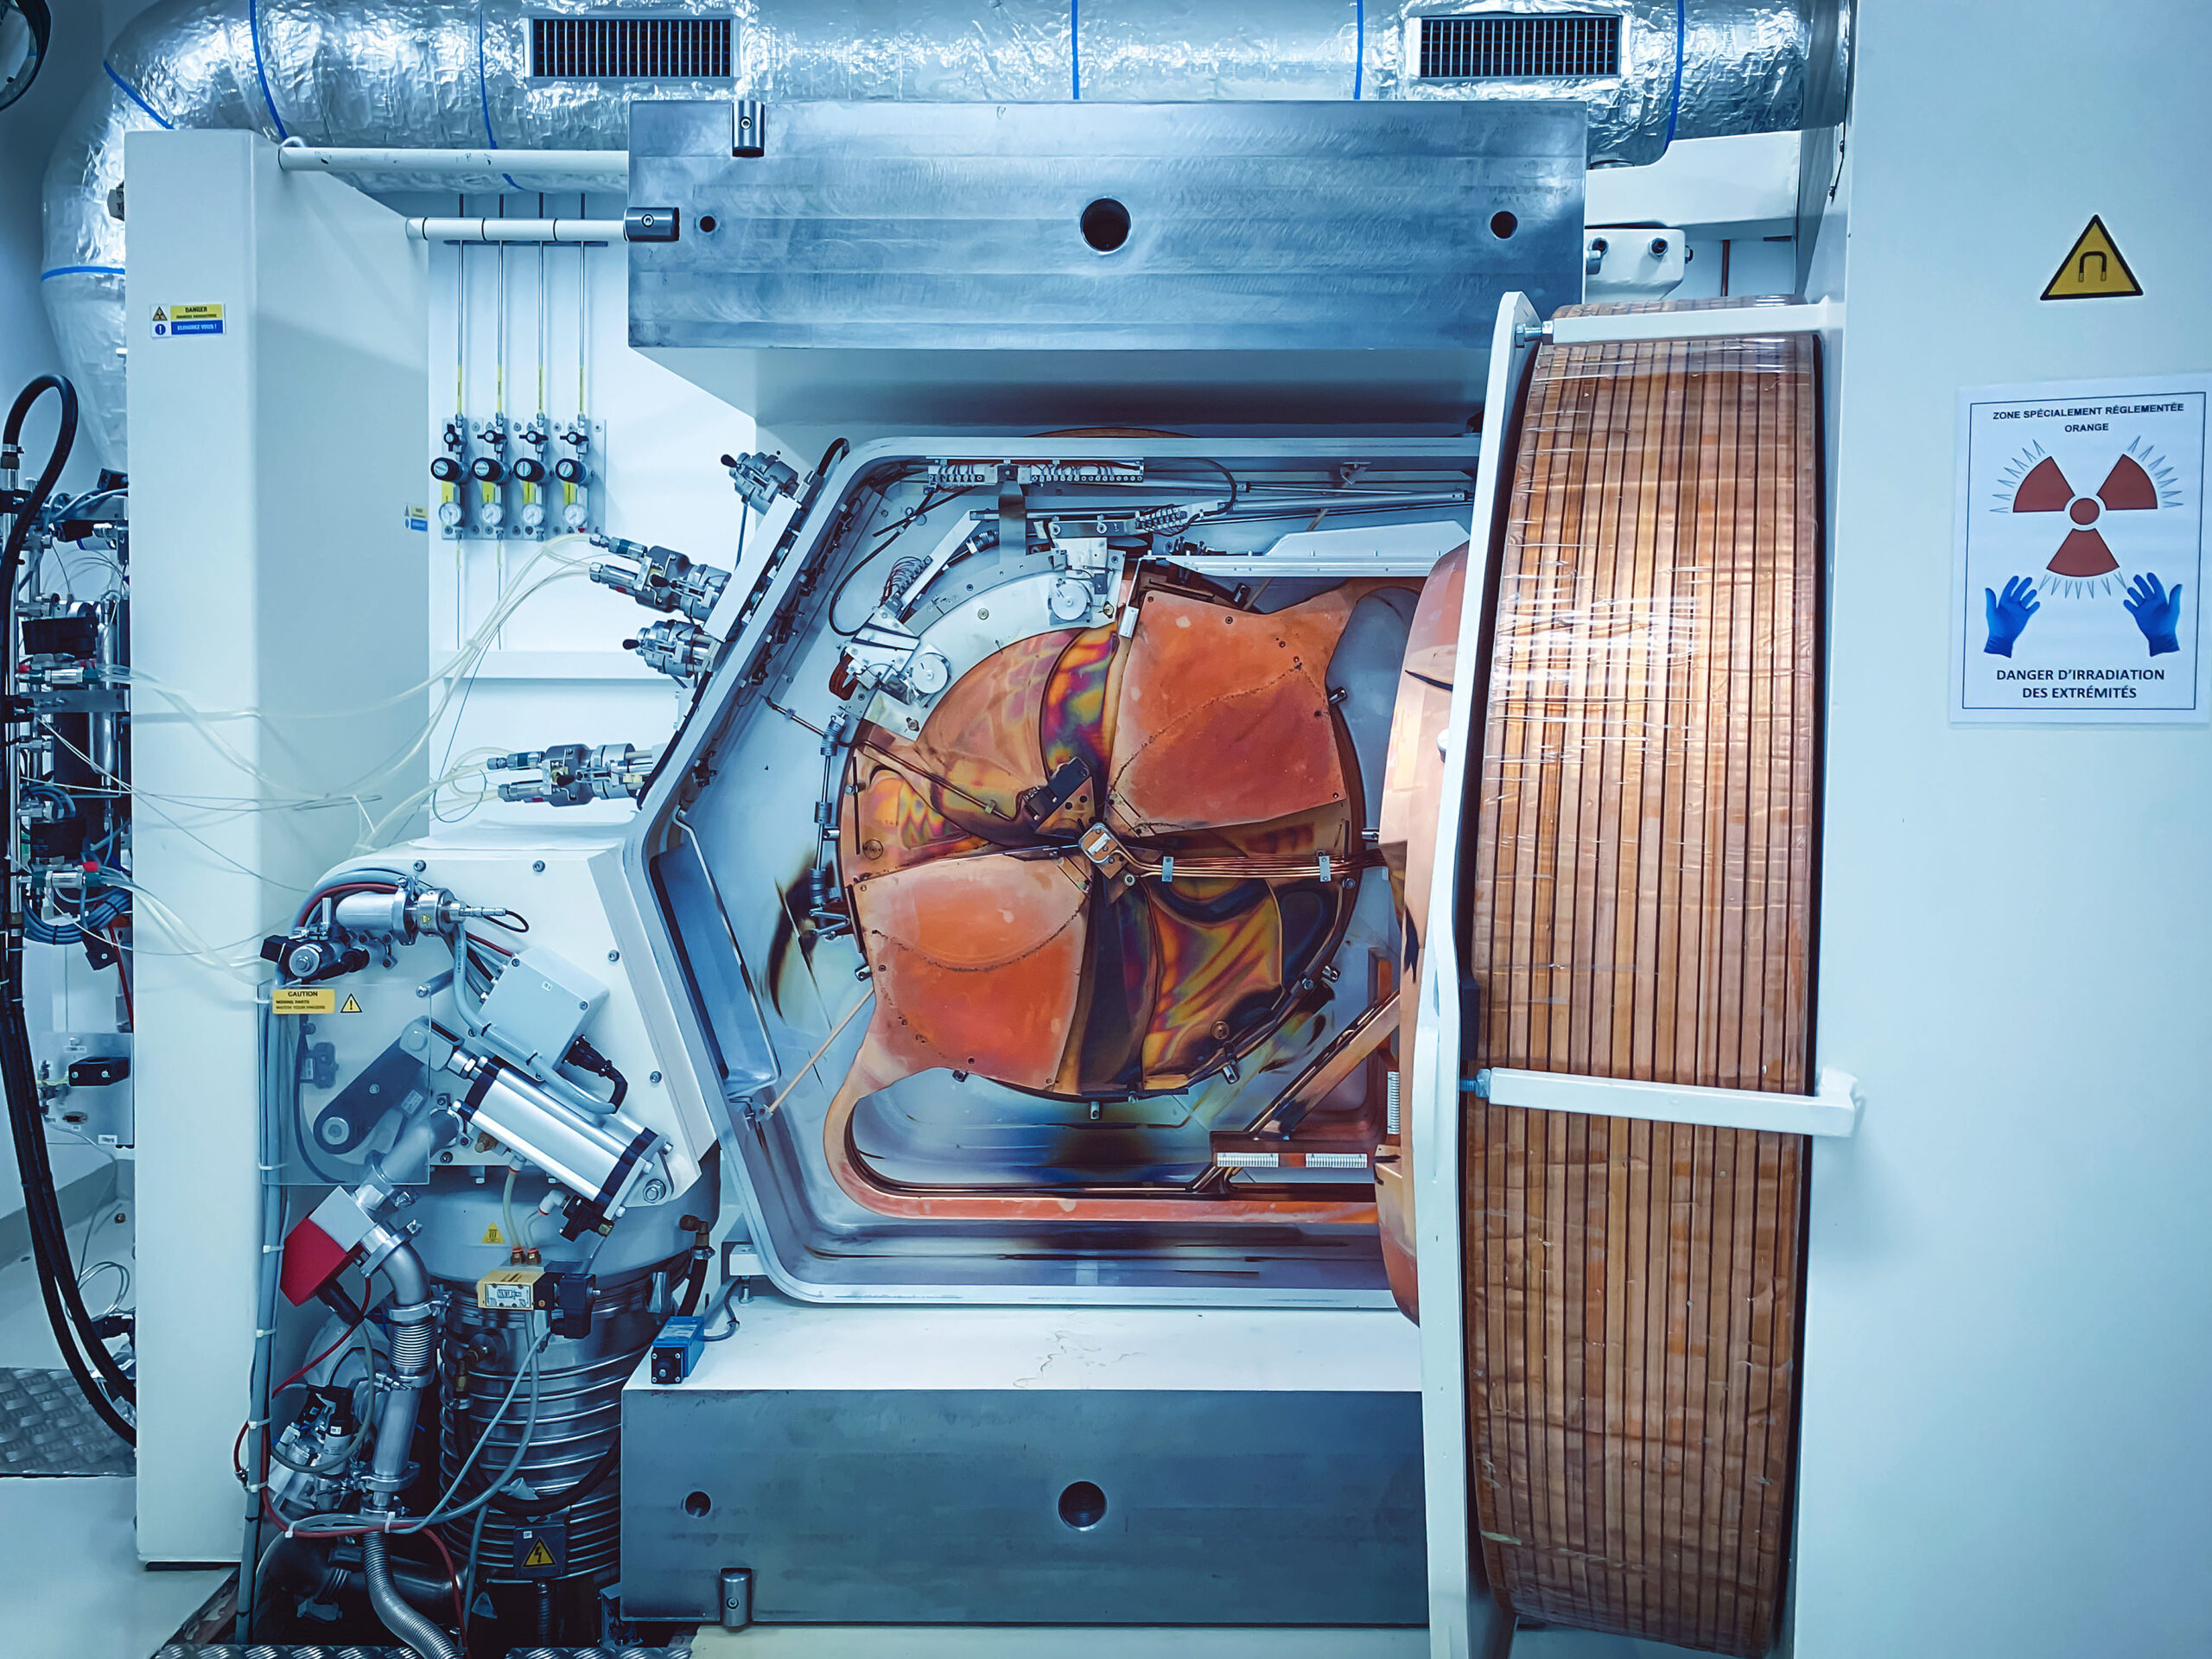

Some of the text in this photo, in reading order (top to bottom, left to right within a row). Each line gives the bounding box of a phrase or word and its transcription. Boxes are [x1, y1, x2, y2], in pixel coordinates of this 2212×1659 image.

[1993, 402, 2184, 420] ZONE SPÉCIALEMENT RÉGLEMENTÉE
[2064, 423, 2109, 433] ORANGE
[1996, 670, 2054, 681] DANGER
[2022, 685, 2137, 698] DES EXTRÉMITÉS
